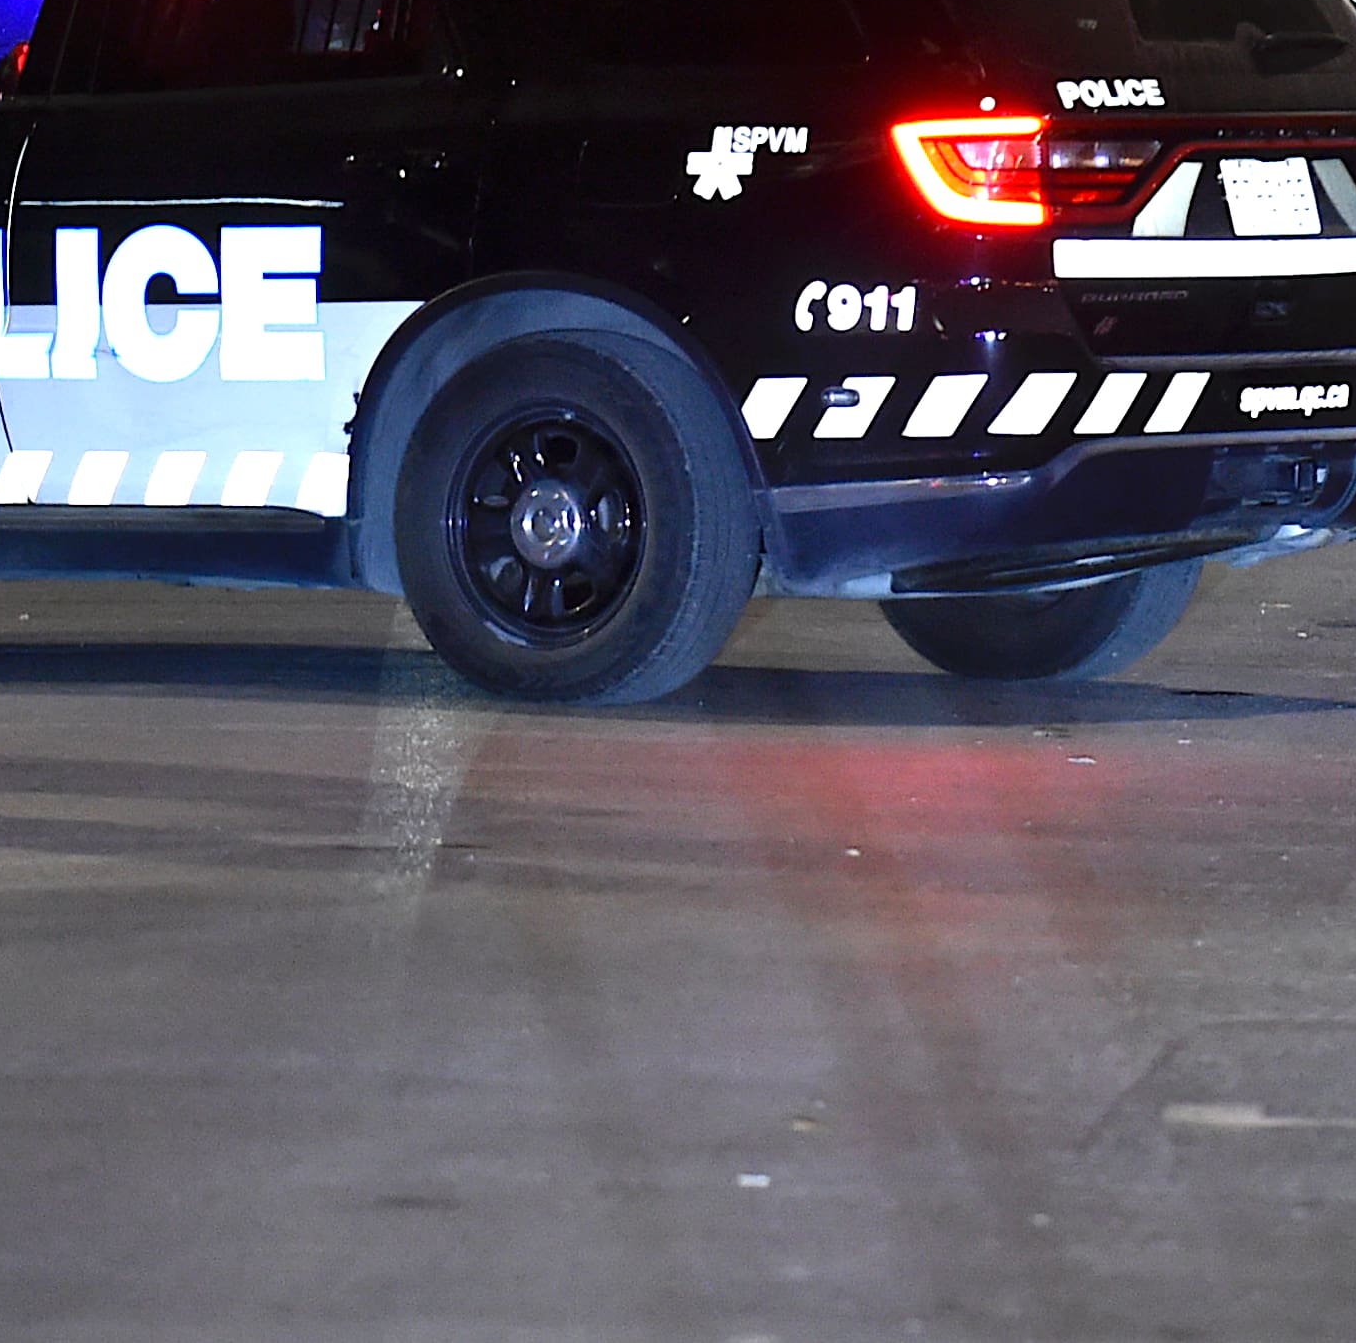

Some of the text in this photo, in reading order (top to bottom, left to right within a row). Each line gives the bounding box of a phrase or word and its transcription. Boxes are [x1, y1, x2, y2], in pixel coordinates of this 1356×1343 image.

[1055, 78, 1166, 110] POLICE
[732, 125, 809, 153] SPVM
[826, 283, 917, 332] 911
